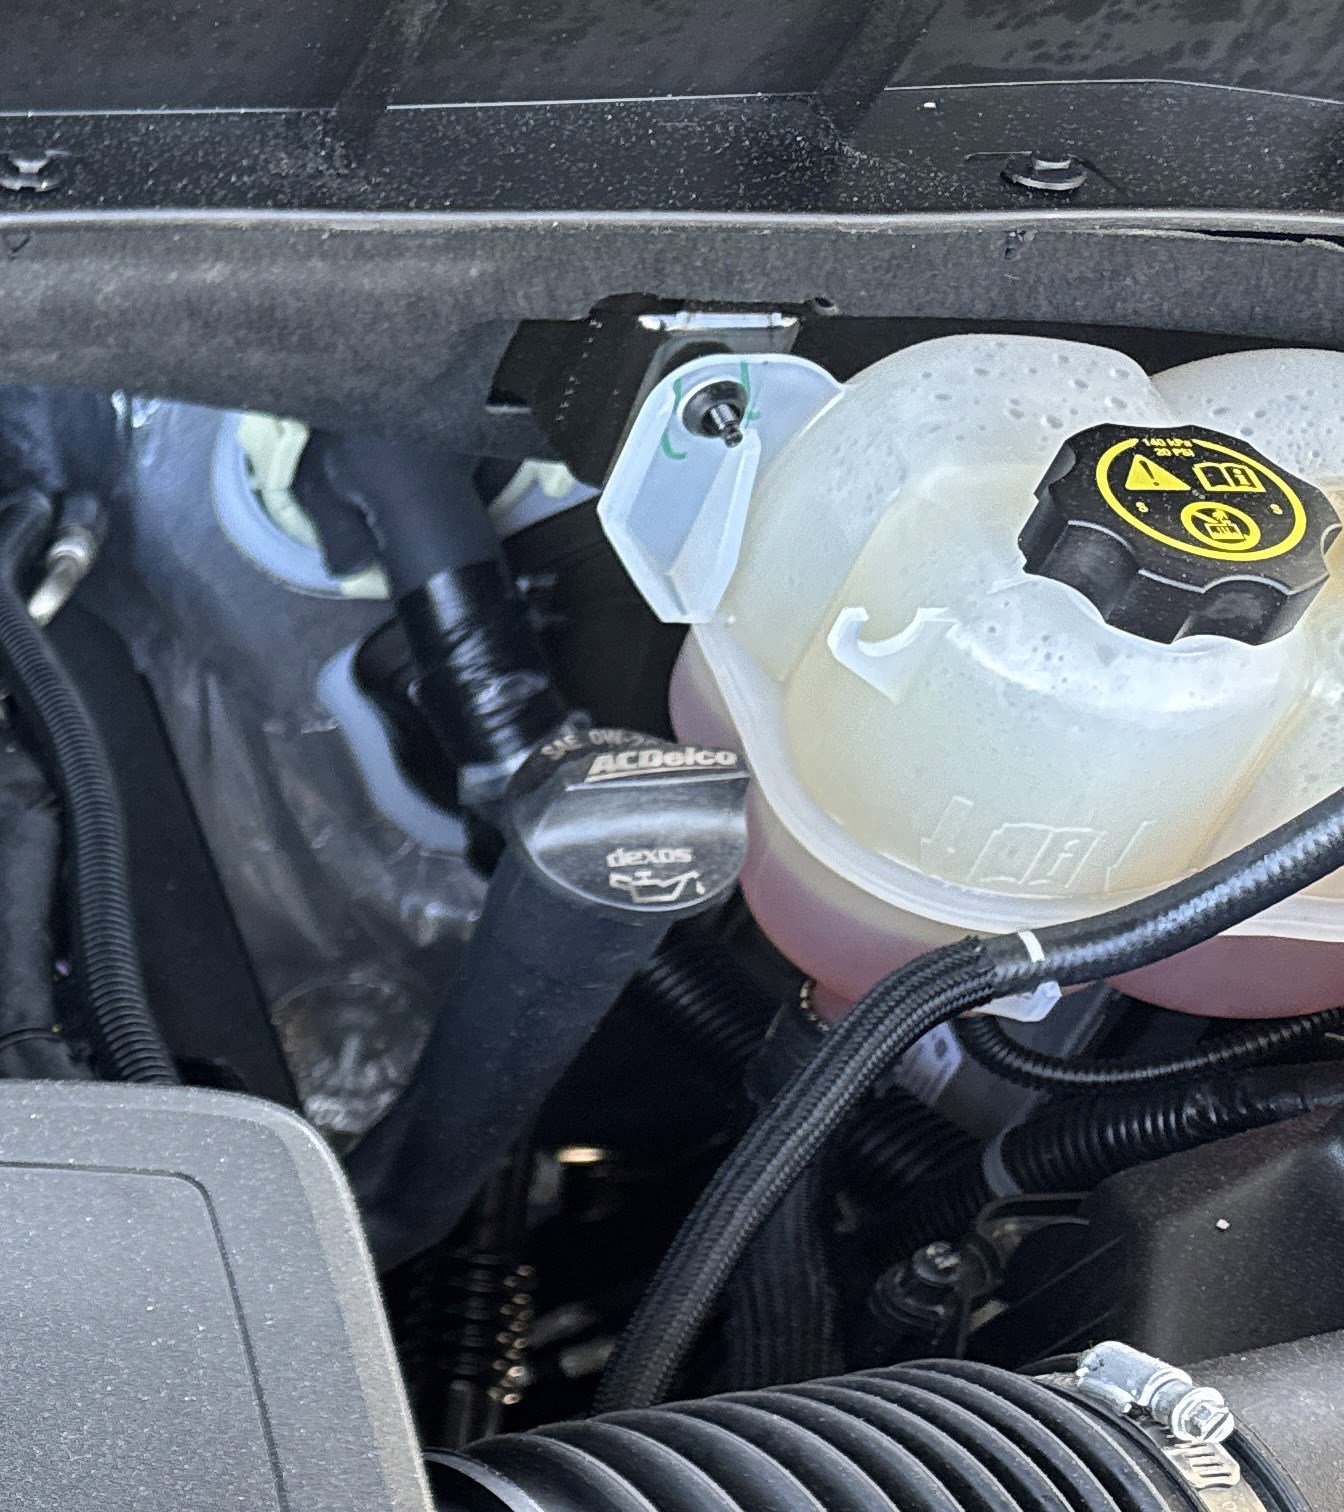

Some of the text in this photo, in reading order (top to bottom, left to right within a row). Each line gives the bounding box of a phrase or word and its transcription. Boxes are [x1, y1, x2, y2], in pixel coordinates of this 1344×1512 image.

[1141, 437, 1167, 447] 140
[1153, 447, 1172, 457] 20
[587, 747, 739, 776] ACDelco
[606, 847, 694, 868] dexos
